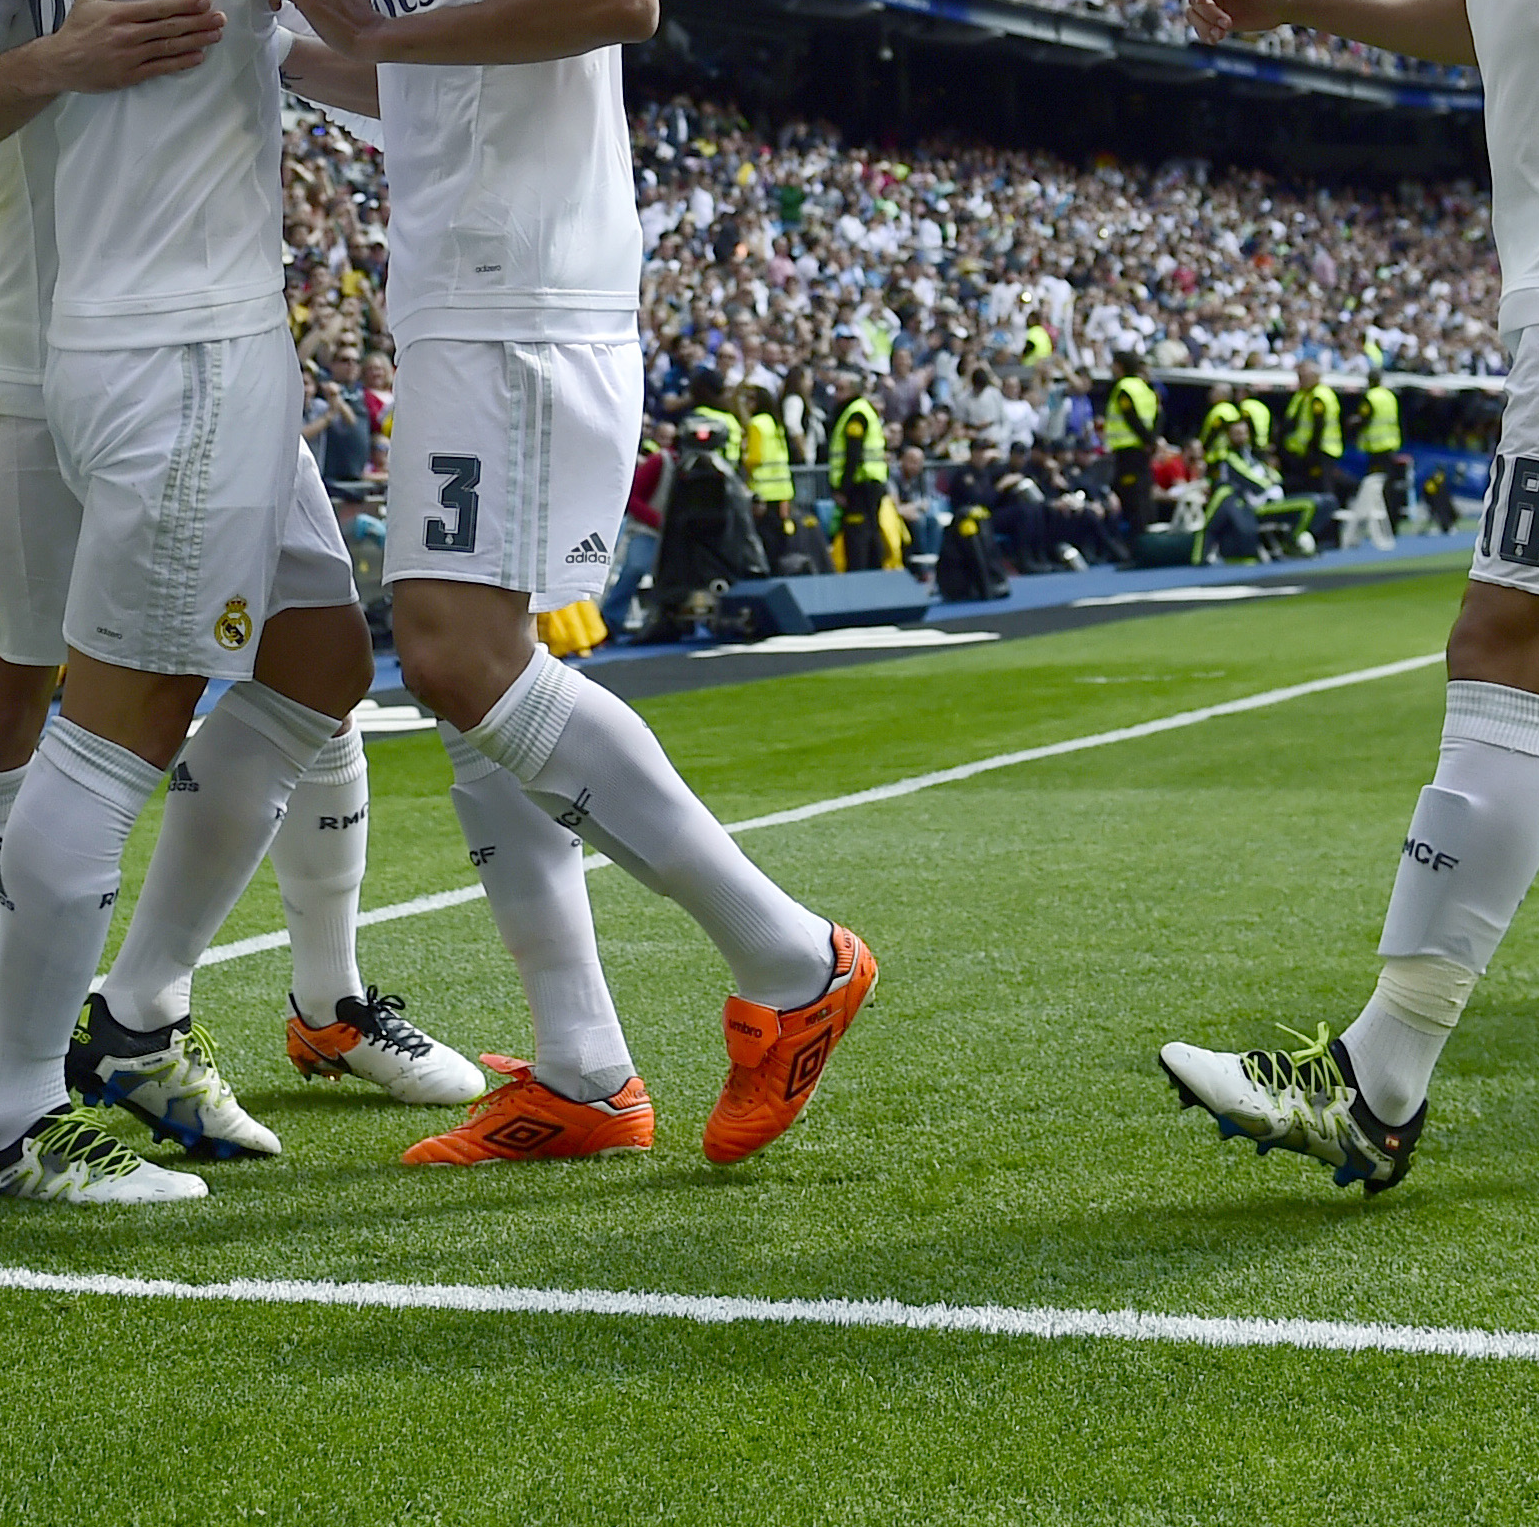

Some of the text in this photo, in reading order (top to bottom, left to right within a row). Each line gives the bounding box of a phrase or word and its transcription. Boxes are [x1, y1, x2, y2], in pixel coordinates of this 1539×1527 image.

[422, 452, 482, 554] 3
[1402, 837, 1460, 871] MCF
[729, 1018, 763, 1039] umbro
